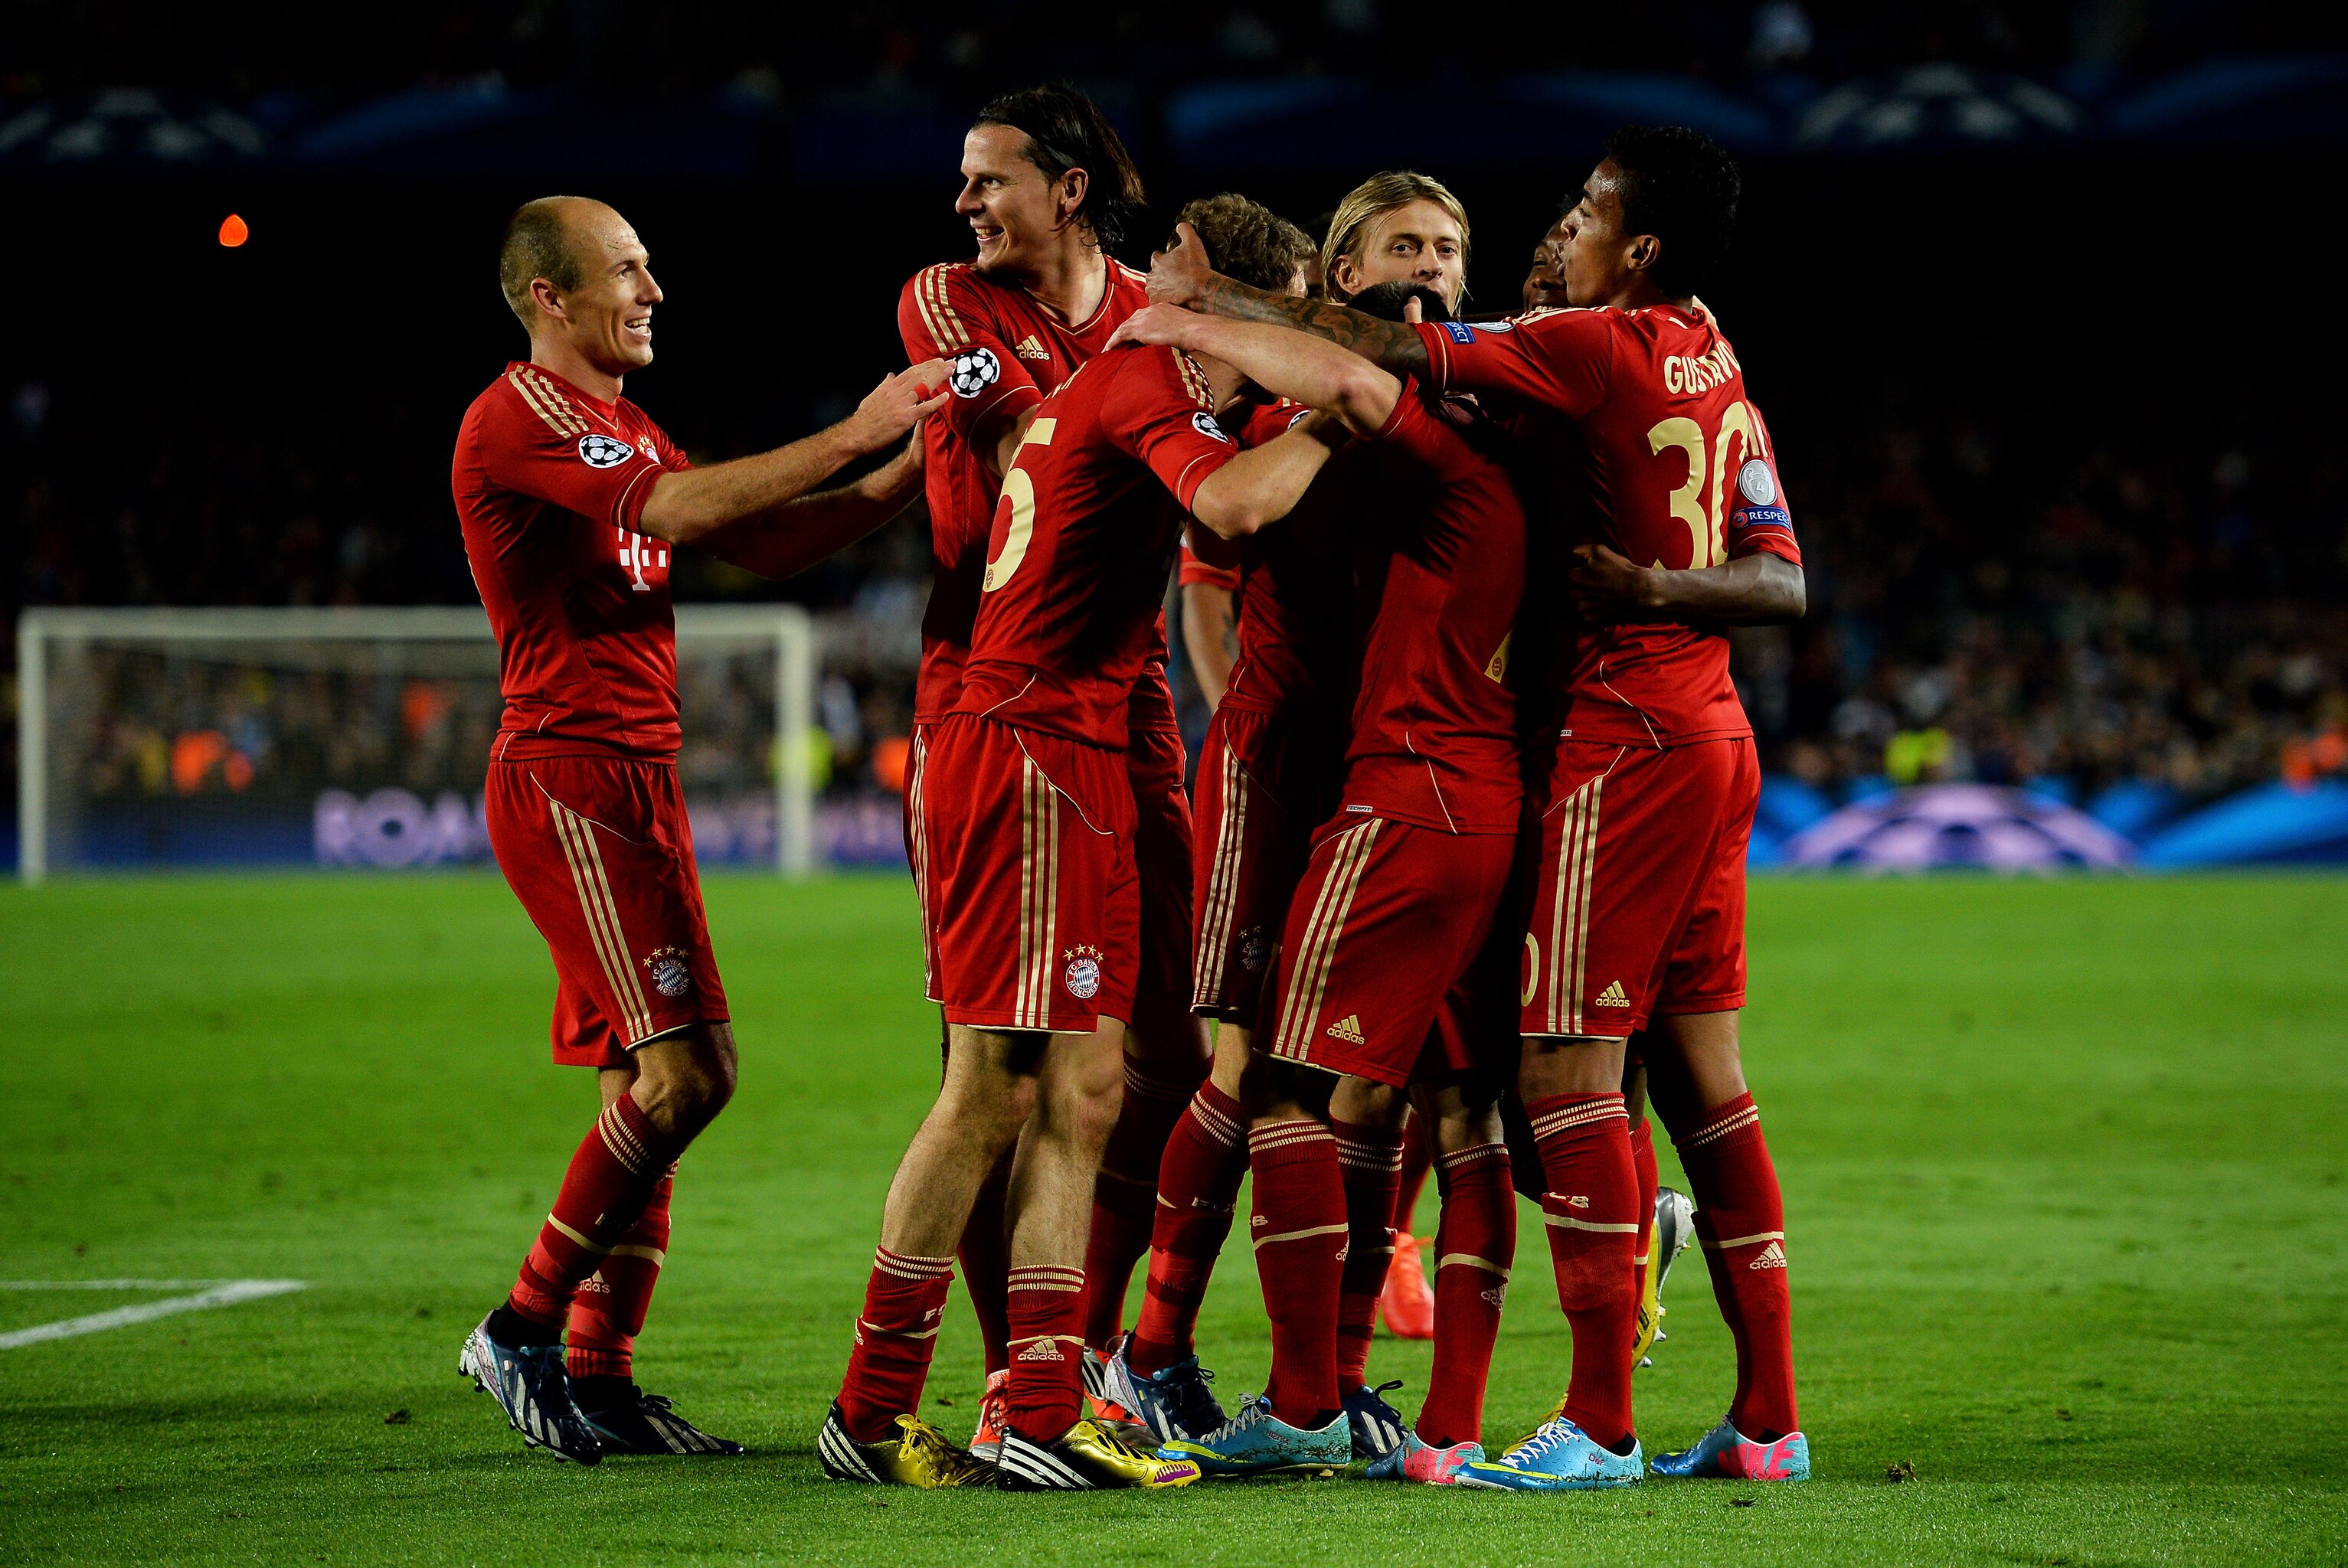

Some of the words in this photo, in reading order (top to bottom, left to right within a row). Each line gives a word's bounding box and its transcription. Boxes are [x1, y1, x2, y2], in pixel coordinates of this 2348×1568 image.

[1647, 400, 1748, 570] 30
[1078, 959, 1099, 978] BAYERN
[1595, 995, 1630, 1008] adidas
[1326, 1027, 1365, 1045] adidas
[1017, 1351, 1065, 1361] adidas
[1717, 1433, 1801, 1481] NIKE
